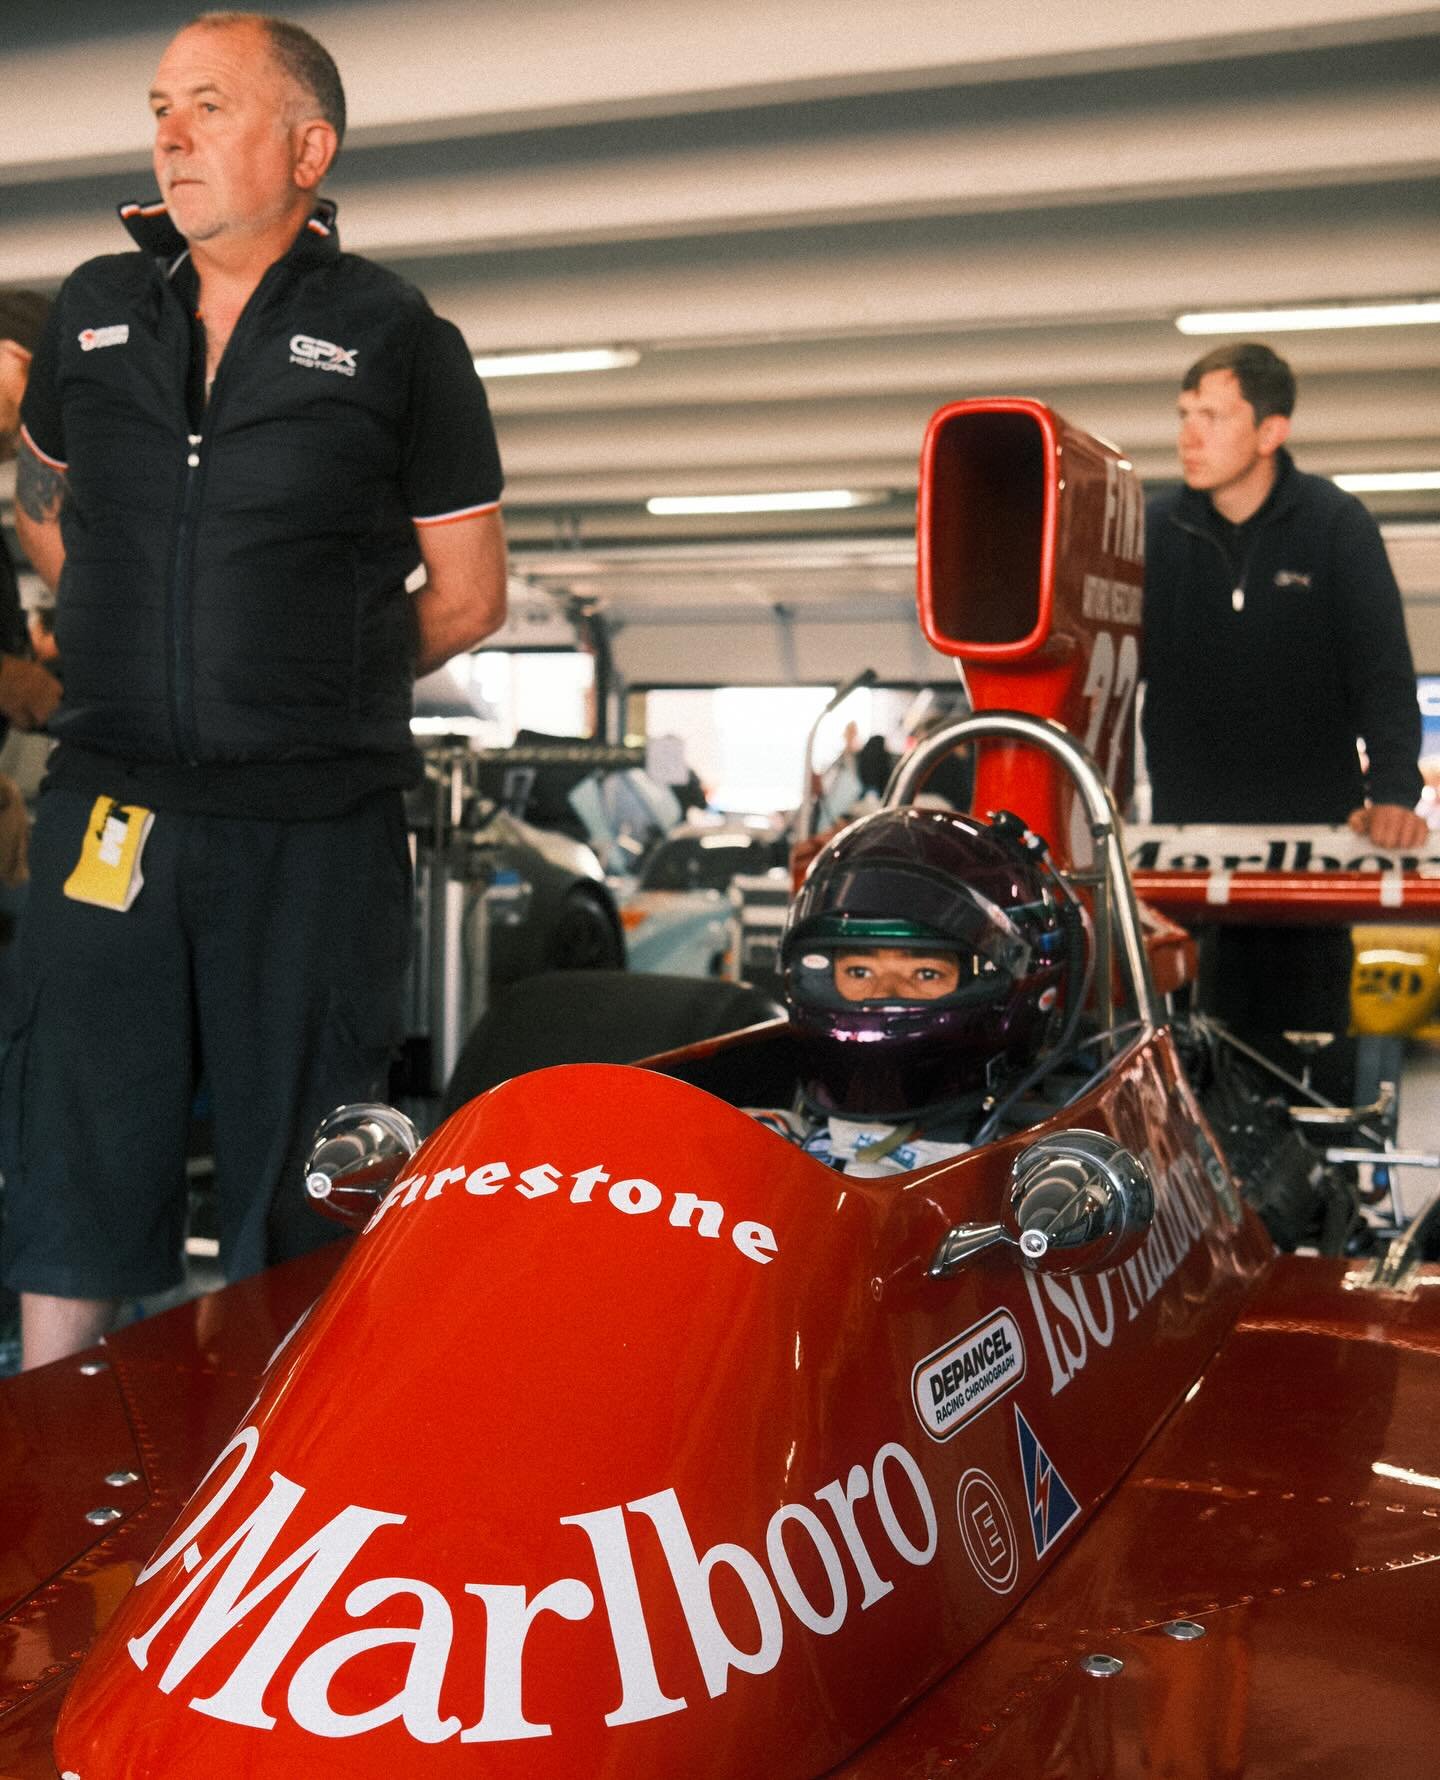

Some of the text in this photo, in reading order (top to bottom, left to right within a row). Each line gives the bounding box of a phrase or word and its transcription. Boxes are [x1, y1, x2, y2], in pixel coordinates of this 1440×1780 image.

[289, 334, 359, 368] GPX
[929, 1327, 1013, 1407] DEPANCEL
[935, 1353, 1017, 1425] RACING CHRONOGRAPH
